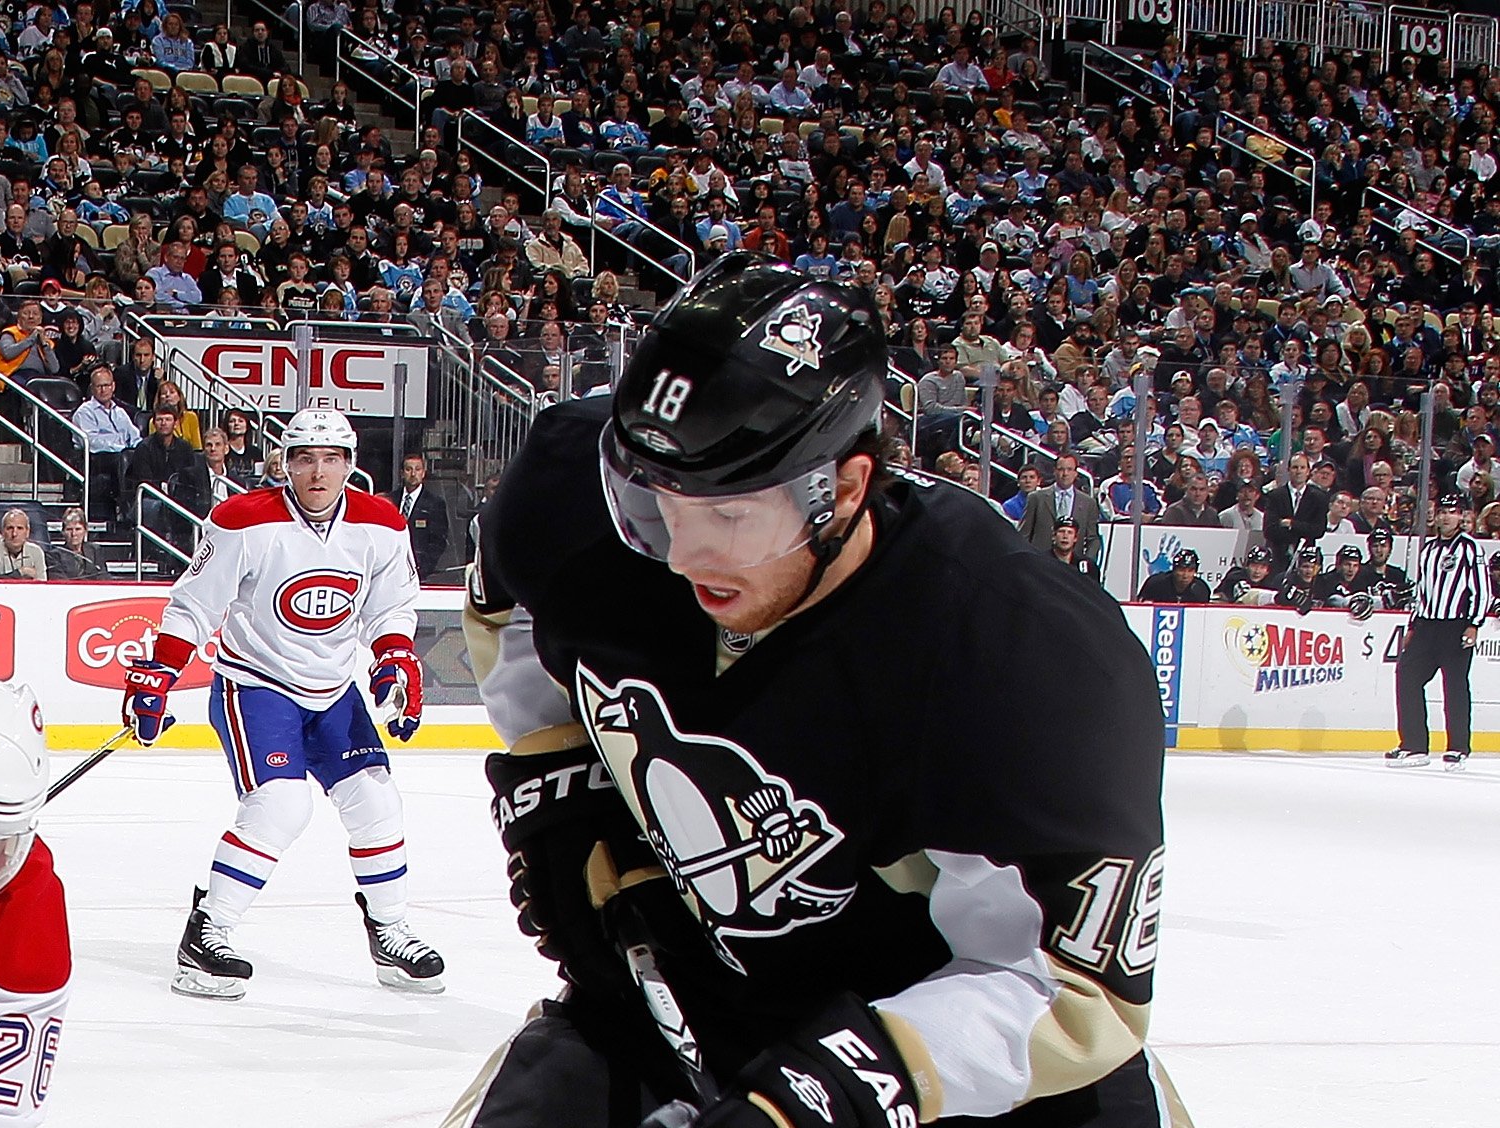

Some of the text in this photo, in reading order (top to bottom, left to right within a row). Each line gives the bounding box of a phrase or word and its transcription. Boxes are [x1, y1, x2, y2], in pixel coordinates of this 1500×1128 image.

[1128, 0, 1172, 24] 103
[1399, 24, 1442, 55] 103
[201, 343, 386, 391] GNC
[643, 370, 691, 422] 18
[1218, 556, 1248, 567] HAV
[1261, 623, 1344, 668] MEGA
[124, 669, 162, 688] TON
[1254, 665, 1344, 692] MILLIONS
[492, 761, 615, 832] ASTO
[1052, 845, 1164, 977] 18
